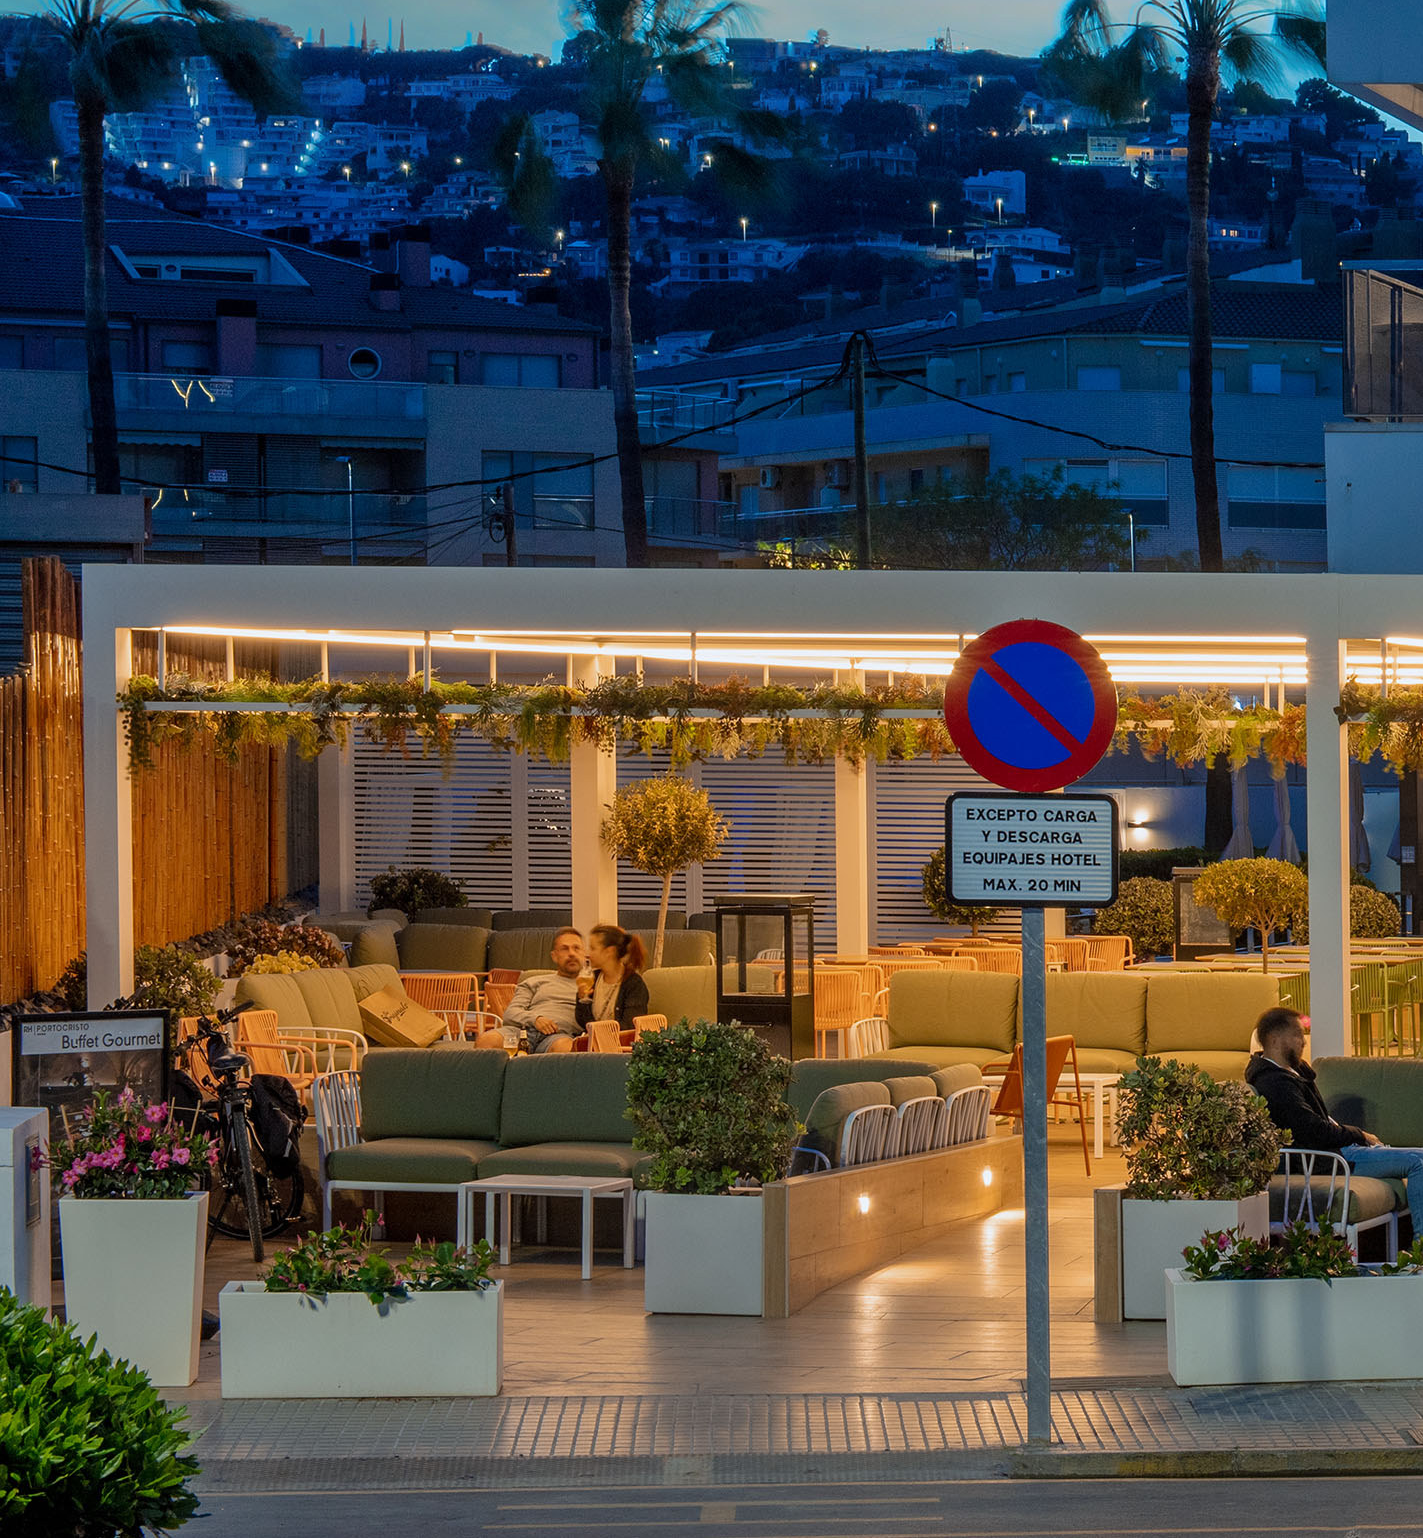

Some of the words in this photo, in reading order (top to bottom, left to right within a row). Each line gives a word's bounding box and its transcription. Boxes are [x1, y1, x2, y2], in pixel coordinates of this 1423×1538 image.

[966, 808, 1038, 822] EXCEPTO
[1043, 810, 1098, 823] CARGA
[981, 830, 991, 843] Y
[997, 830, 1083, 844] DESCARGA
[962, 851, 1046, 866] EQUIPAJES
[1051, 853, 1101, 867] HOTEL
[983, 878, 1022, 891] MAX.
[1028, 879, 1049, 891] 20
[1053, 879, 1081, 892] MIN
[23, 1025, 33, 1033] RH
[36, 1023, 90, 1033] PORTOCRISTO
[61, 1034, 99, 1049] Buffet
[102, 1032, 161, 1048] Gourmet
